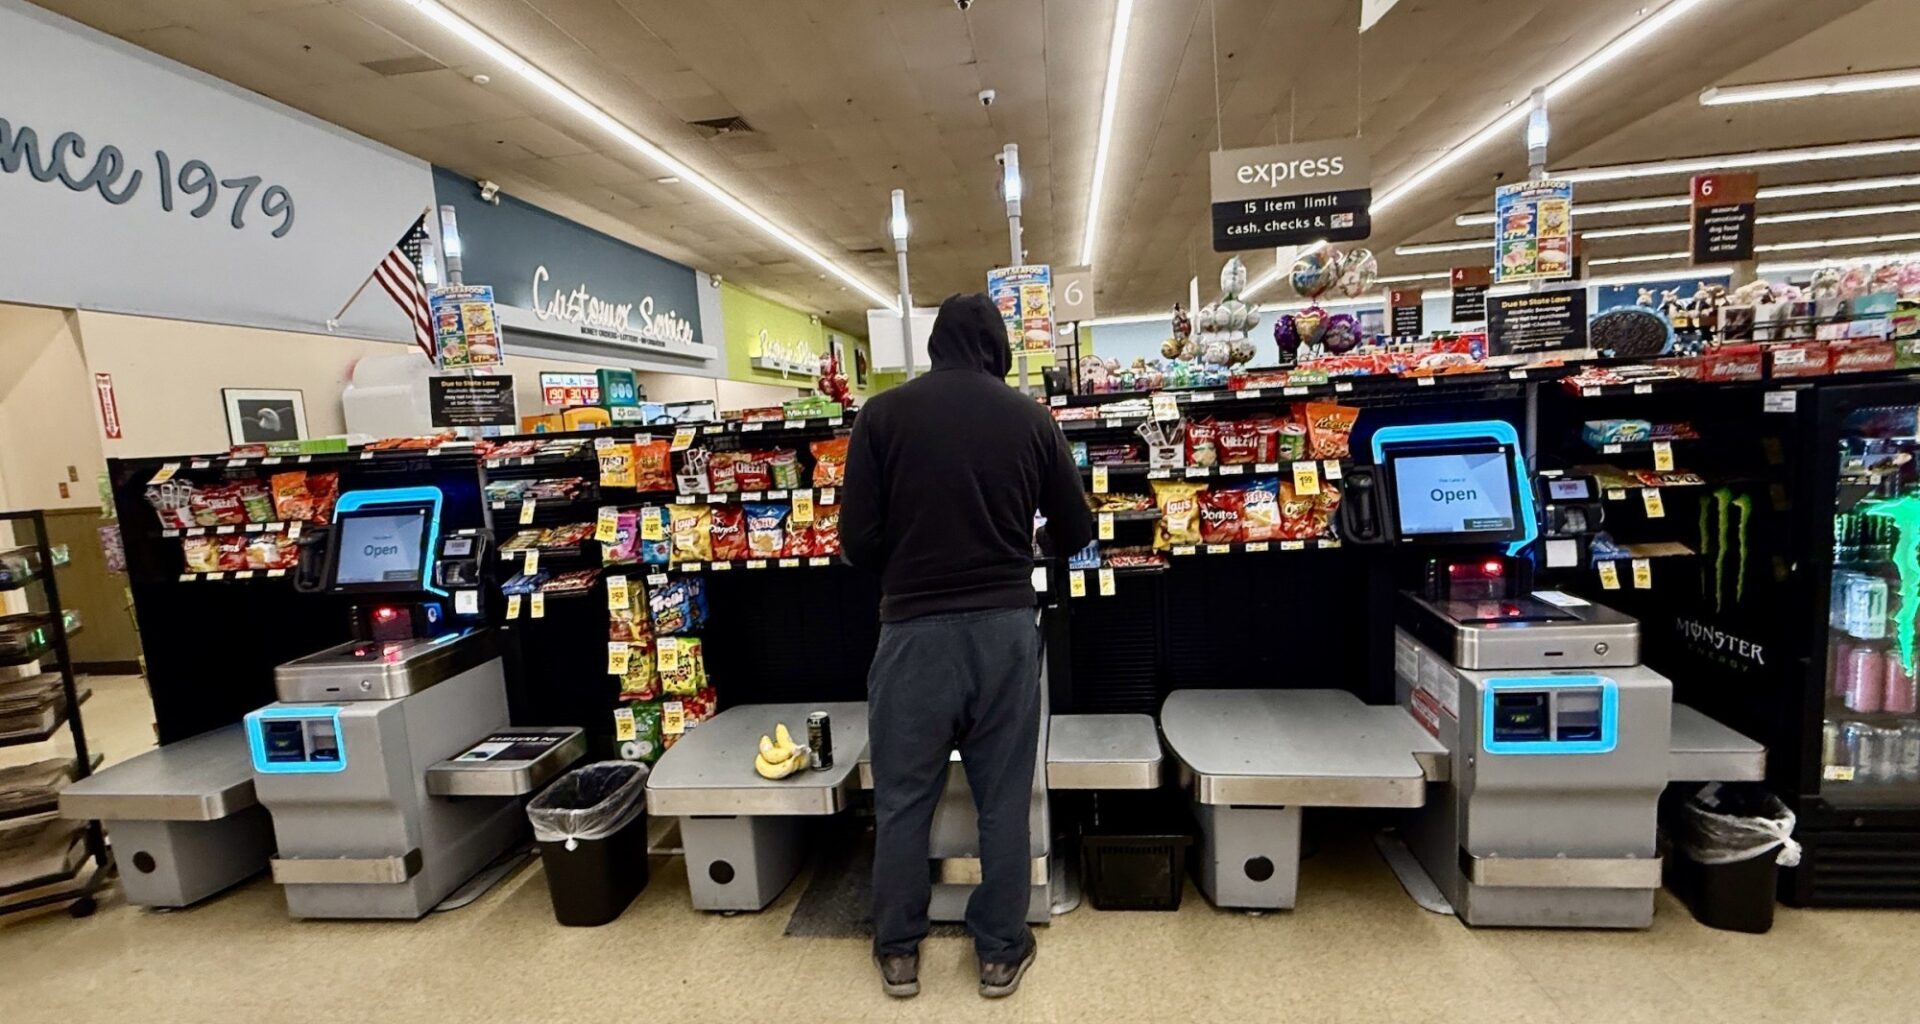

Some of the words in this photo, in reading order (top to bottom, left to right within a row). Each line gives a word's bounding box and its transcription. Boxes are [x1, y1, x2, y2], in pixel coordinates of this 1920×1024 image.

[1237, 156, 1344, 188] express
[156, 150, 294, 238] 1979
[1702, 180, 1713, 196] 6
[1244, 202, 1257, 214] 15
[1304, 194, 1338, 208] limit
[1227, 222, 1260, 235] cash,
[1265, 217, 1309, 231] checks
[1314, 216, 1325, 227] &
[1704, 214, 1746, 224] promotional
[1455, 269, 1463, 280] 4
[1064, 280, 1083, 306] 6
[1394, 293, 1401, 302] 3
[533, 266, 632, 332] Customer
[639, 296, 694, 344] Service
[1501, 301, 1519, 309] Due
[1519, 299, 1528, 307] to
[1528, 297, 1550, 306] State
[1550, 295, 1572, 304] Laws
[1535, 305, 1566, 313] Beverages
[1539, 312, 1571, 321] purchased
[570, 389, 581, 400] 30
[1430, 489, 1477, 505] Open
[1201, 508, 1238, 520] Doritos
[364, 545, 398, 558] Open
[1676, 617, 1765, 665] MONSTER
